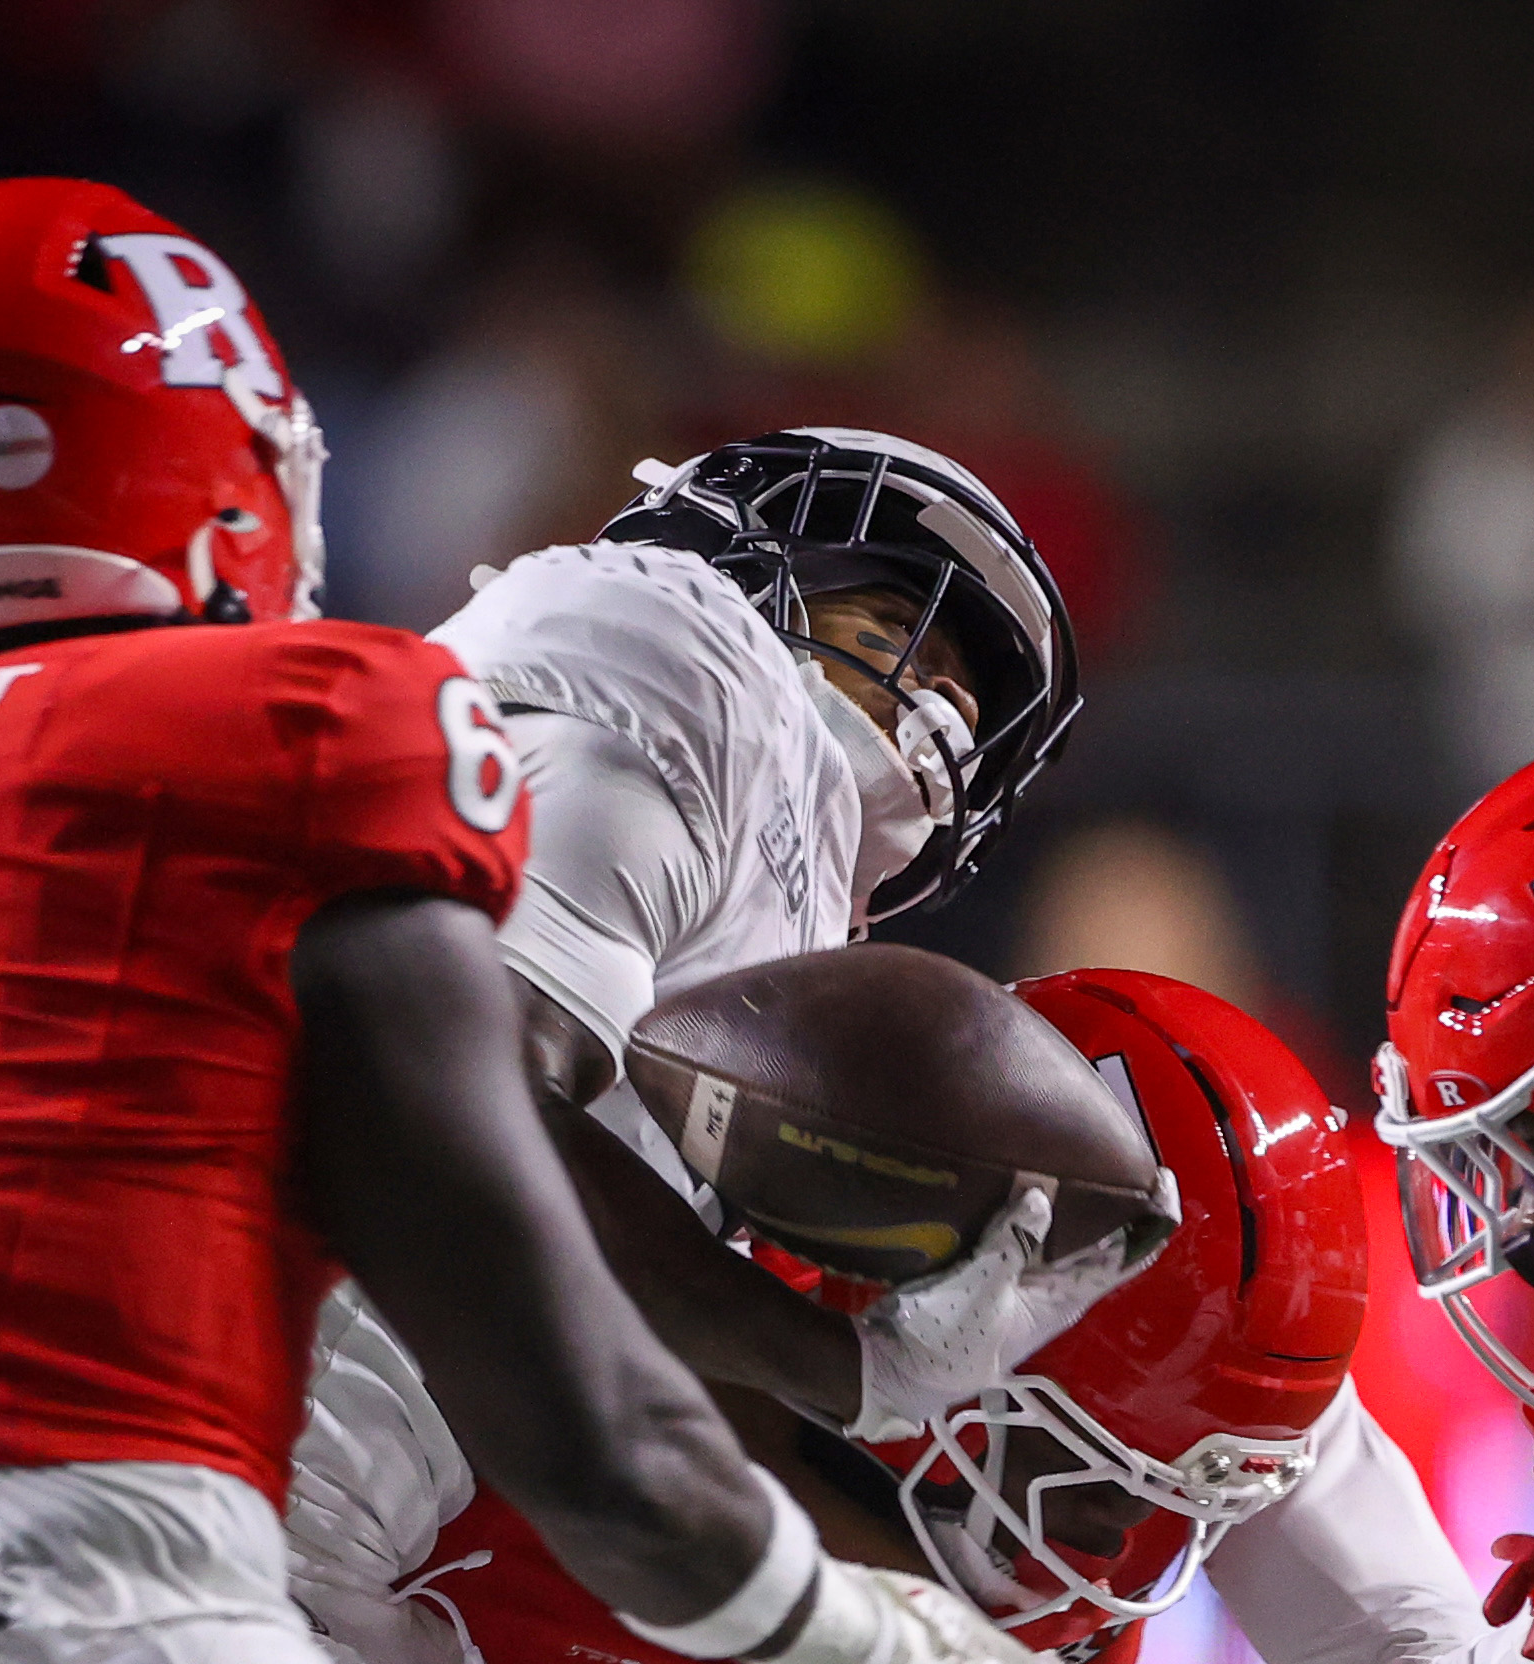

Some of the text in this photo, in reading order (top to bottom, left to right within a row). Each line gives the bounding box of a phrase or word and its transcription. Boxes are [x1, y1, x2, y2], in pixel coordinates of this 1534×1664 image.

[96, 231, 285, 399] R
[435, 675, 521, 834] 6
[1434, 1079, 1467, 1107] R
